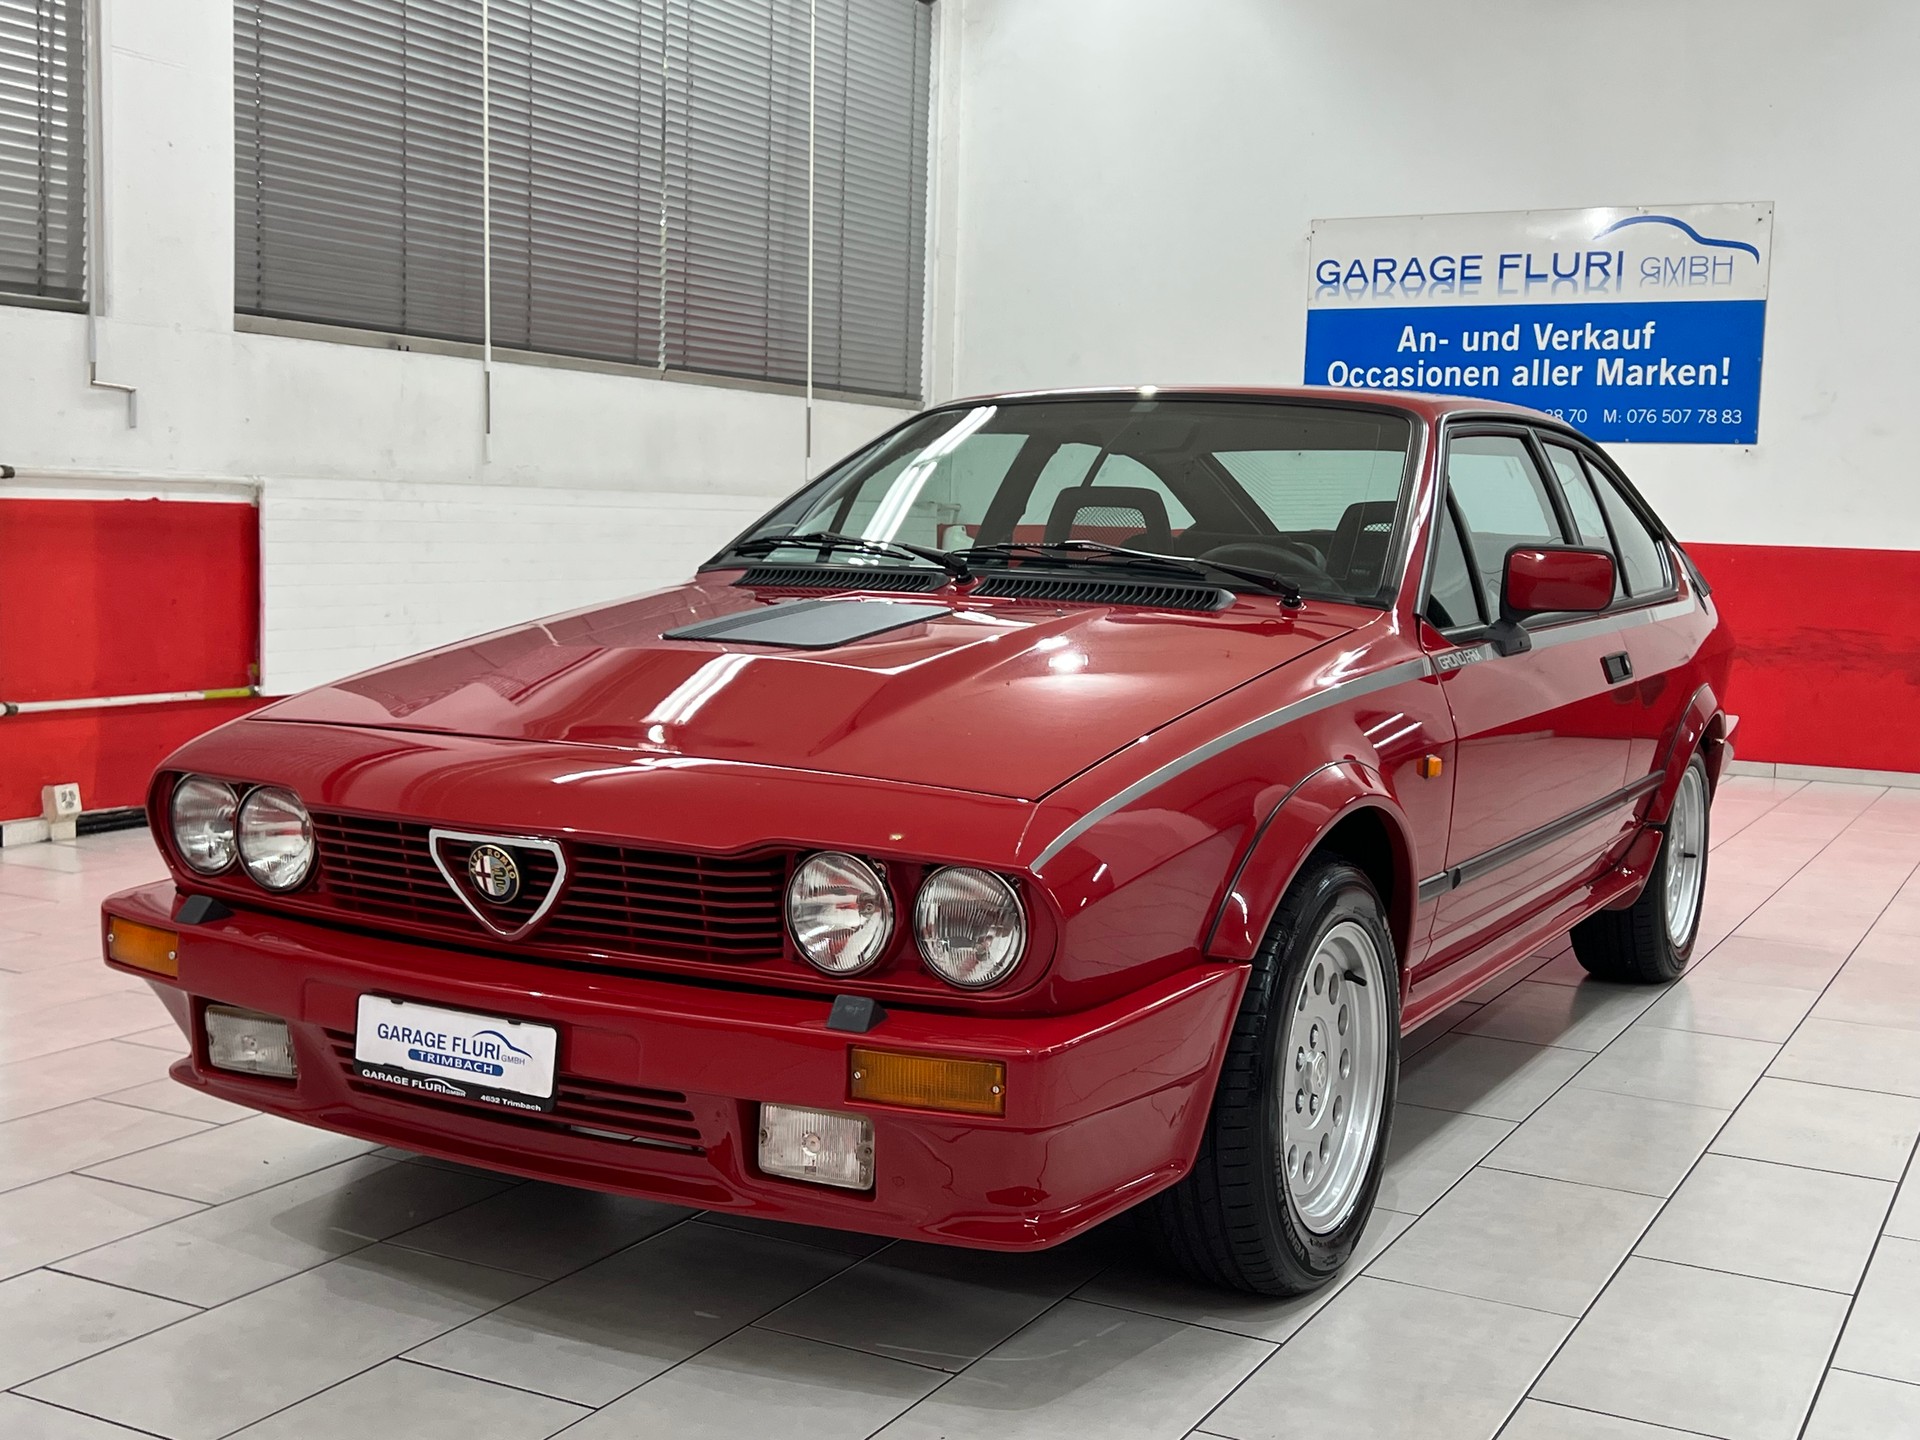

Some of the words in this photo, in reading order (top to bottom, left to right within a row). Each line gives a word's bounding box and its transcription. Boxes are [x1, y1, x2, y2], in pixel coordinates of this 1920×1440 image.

[1316, 255, 1483, 285] GARAGE
[1498, 250, 1624, 279] FLURI
[1640, 255, 1734, 277] GMBH
[1397, 326, 1449, 352] An-
[1462, 324, 1520, 352] und
[1533, 321, 1656, 351] Verkauf
[1327, 359, 1499, 387] Occasionen
[1511, 358, 1583, 386] aller
[1596, 357, 1731, 386] Marken!
[1568, 408, 1588, 424] 70
[1603, 409, 1622, 424] M:
[1626, 408, 1657, 424] 076
[1661, 408, 1692, 424] 507
[1697, 408, 1718, 424] 78
[1721, 408, 1742, 424] 83
[470, 850, 484, 875] ALFA
[487, 848, 516, 879] ROMEO
[377, 1023, 447, 1051] GARAGE
[452, 1036, 501, 1061] FLURI
[501, 1054, 526, 1066] GMBH
[418, 1051, 493, 1074] TRIMBACH
[362, 1069, 409, 1086] GARAGE
[411, 1079, 447, 1094] FLURI
[502, 1098, 542, 1111] Trimbach
